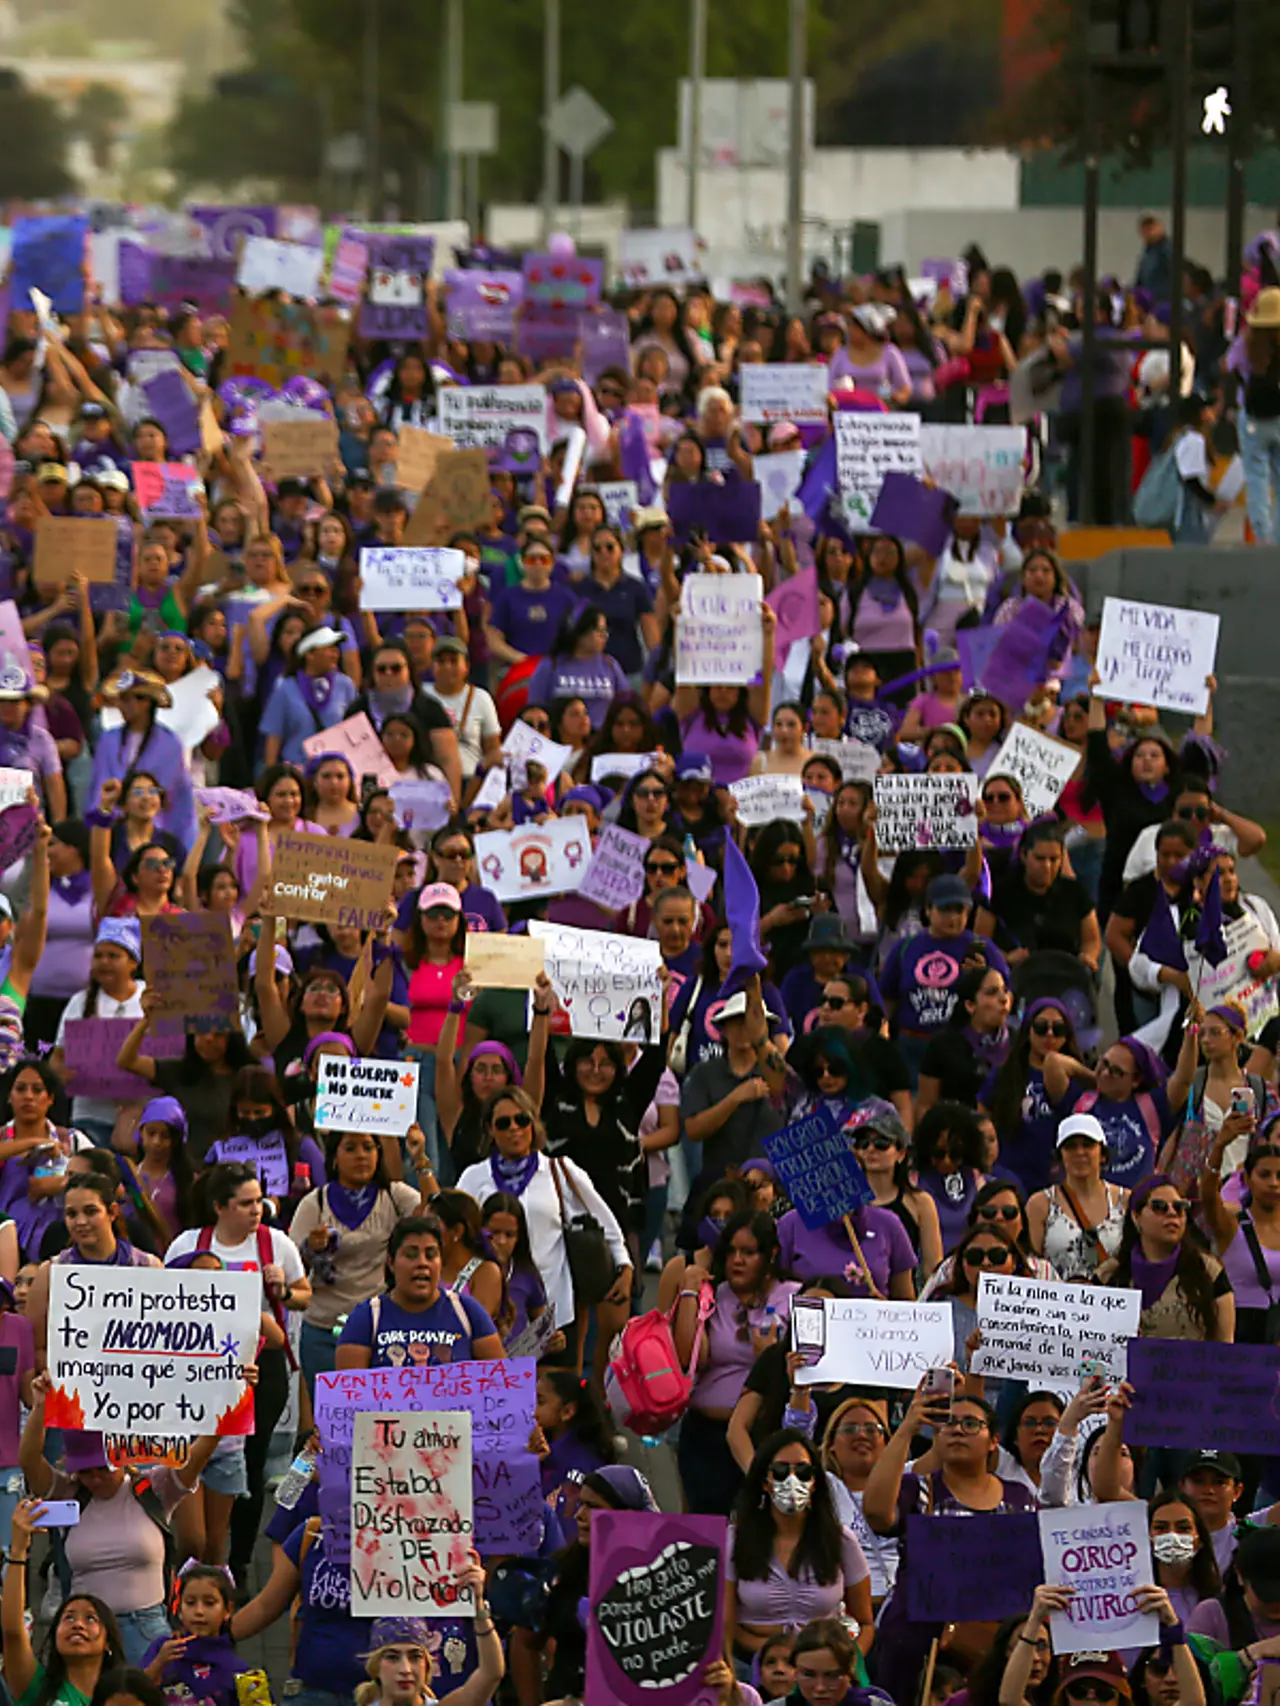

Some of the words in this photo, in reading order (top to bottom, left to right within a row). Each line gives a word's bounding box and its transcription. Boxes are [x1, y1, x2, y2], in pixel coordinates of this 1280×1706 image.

[325, 1062, 346, 1078] MI
[350, 1067, 399, 1083] CUERPO
[328, 1081, 347, 1096] NO
[352, 1085, 395, 1100] QUIERE
[64, 1272, 95, 1310] Si
[103, 1288, 133, 1308] mi
[141, 1283, 236, 1320] protesta
[830, 1302, 867, 1320] Las
[1007, 1281, 1021, 1295] la
[1080, 1289, 1095, 1306] la
[1101, 1296, 1127, 1311] que
[58, 1316, 89, 1348] te
[1079, 1329, 1107, 1342] pero
[983, 1356, 1006, 1370] que
[1038, 1339, 1055, 1355] de
[1062, 1343, 1075, 1358] la
[57, 1360, 134, 1387] imagina
[142, 1358, 175, 1389] qué
[186, 1355, 245, 1383] siento
[317, 1370, 393, 1389] VENTE
[398, 1361, 508, 1387] CHIKITA
[402, 1388, 417, 1400] A
[432, 1376, 521, 1397] GUSTAR
[93, 1392, 120, 1419] Yo
[128, 1402, 165, 1429] por
[176, 1393, 205, 1422] tu
[374, 1419, 407, 1449] Tu
[413, 1428, 461, 1449] amor
[355, 1466, 442, 1496] Estaba
[353, 1502, 472, 1537] Disfrazado
[1051, 1531, 1069, 1545] TE
[1072, 1525, 1113, 1540] CANSAS
[1116, 1522, 1131, 1537] DE
[401, 1539, 434, 1560] DE
[1061, 1542, 1138, 1572] OIRLO?
[352, 1566, 473, 1602] Violencia
[598, 1601, 643, 1621] porque
[649, 1575, 696, 1608] cuando
[697, 1558, 717, 1579] me
[626, 1578, 652, 1597] Hoy
[655, 1556, 690, 1590] grito
[1120, 1573, 1136, 1586] DE
[601, 1590, 712, 1647] VIOLASTE
[622, 1654, 644, 1671] no
